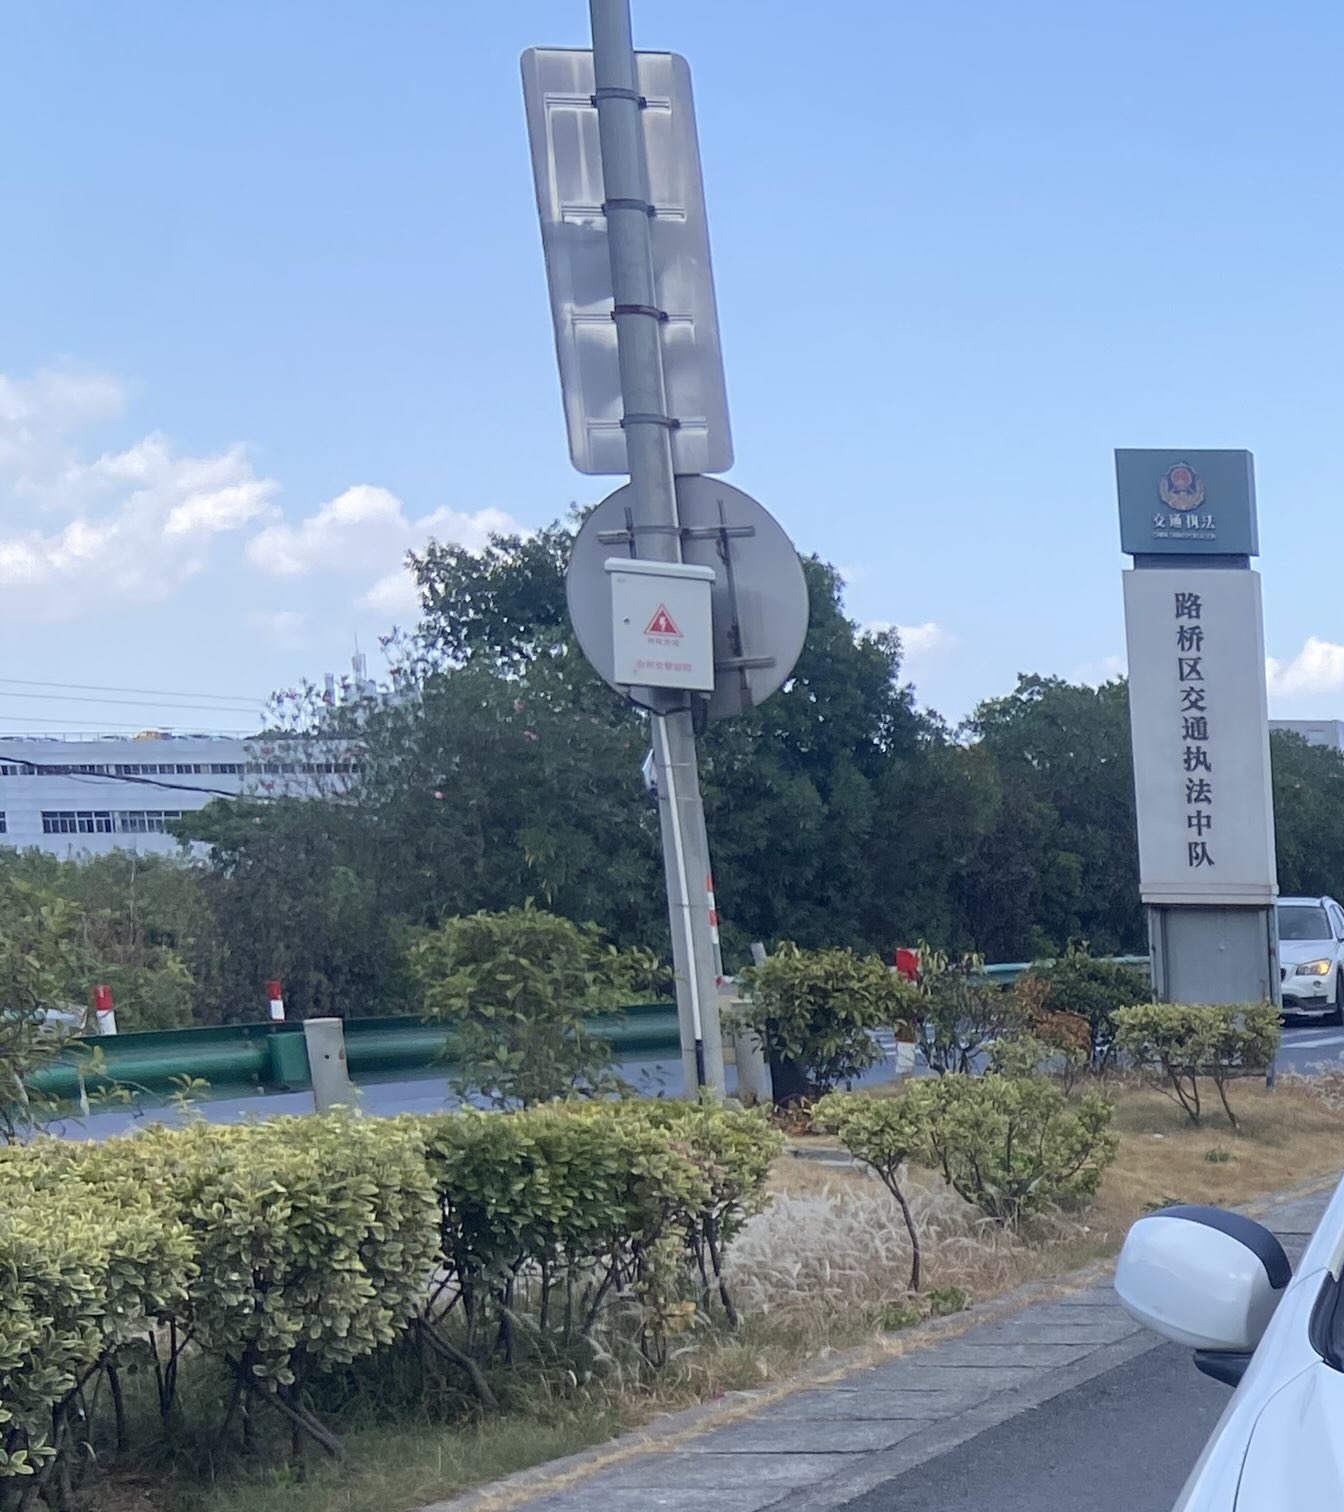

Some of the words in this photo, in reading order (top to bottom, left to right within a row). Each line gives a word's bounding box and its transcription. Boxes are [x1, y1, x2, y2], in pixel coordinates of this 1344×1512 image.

[1174, 591, 1216, 868] 路桥区交通执法中队
